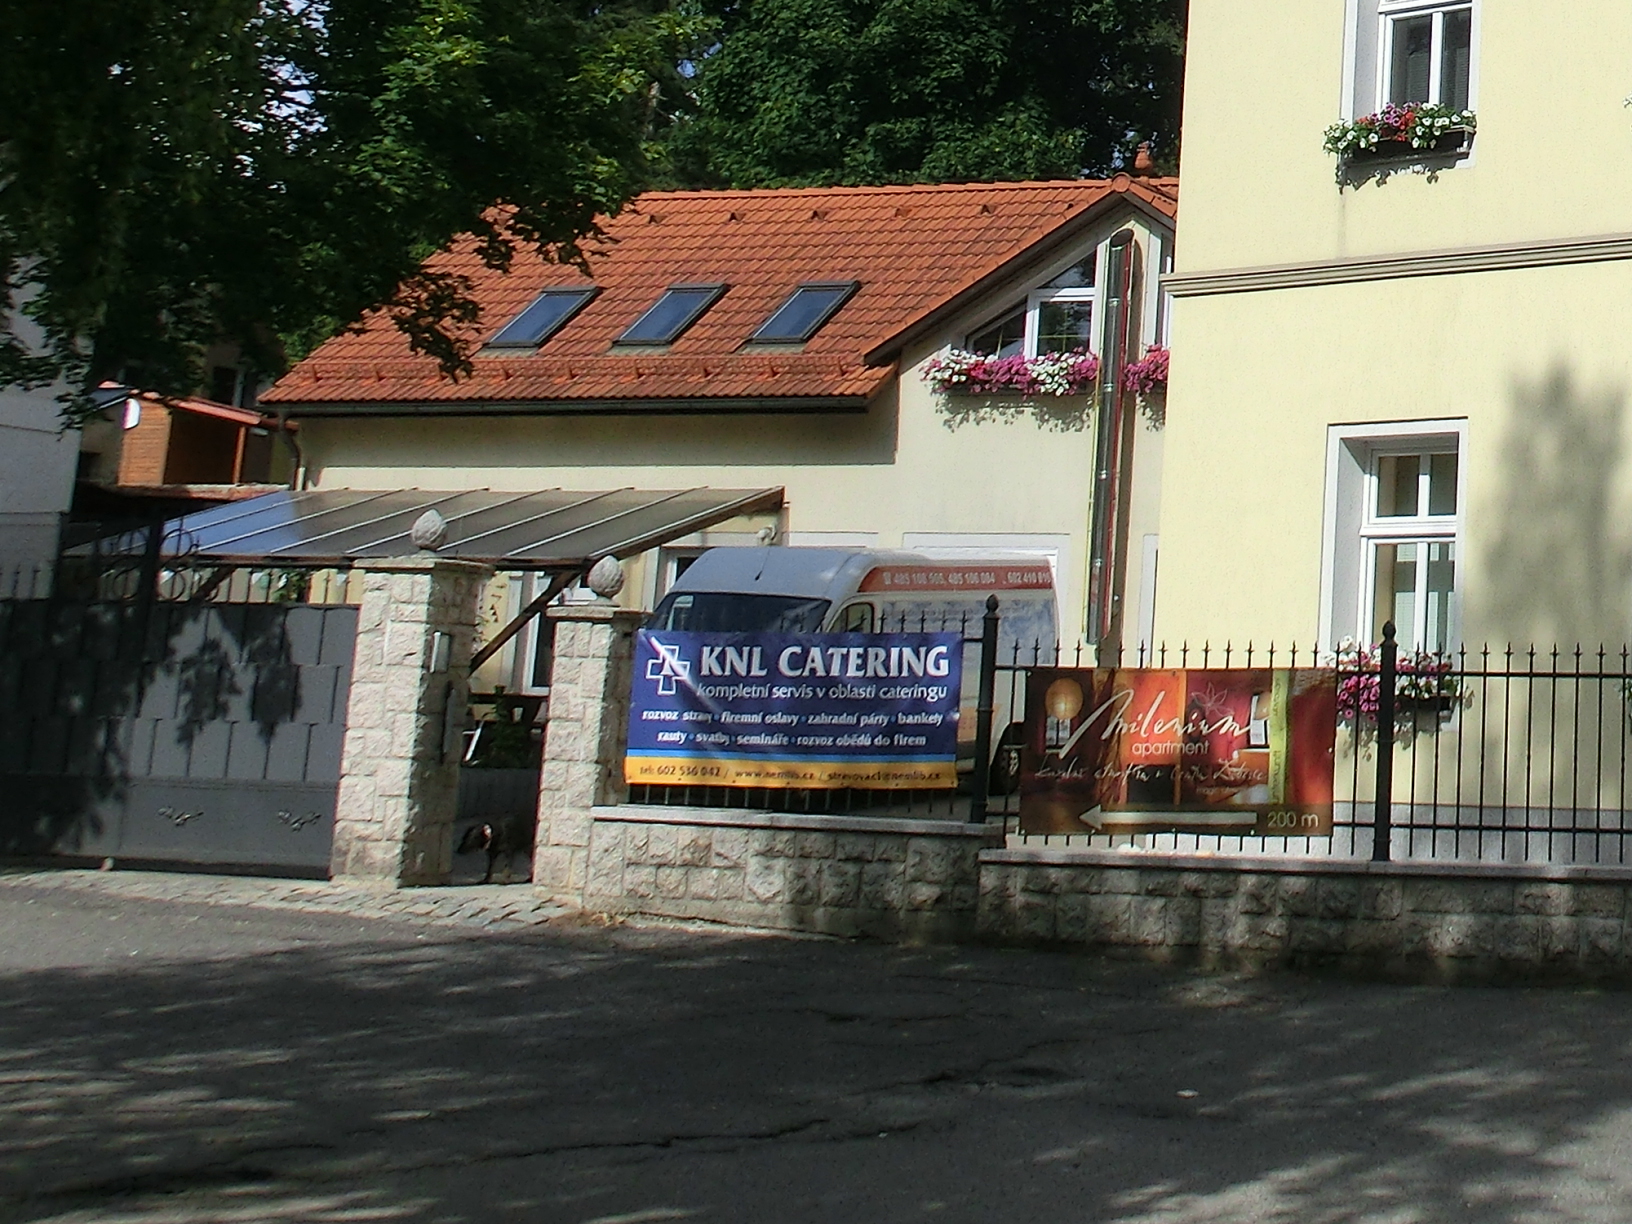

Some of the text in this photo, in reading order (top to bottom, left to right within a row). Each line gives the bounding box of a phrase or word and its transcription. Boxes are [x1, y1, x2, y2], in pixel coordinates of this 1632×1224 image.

[701, 645, 950, 677] KNL CATERING
[697, 683, 948, 702] kompletní servis v oblasti cateringu
[642, 710, 680, 721] rozvoz
[721, 711, 762, 724] firemní
[764, 712, 800, 725] oslavy
[807, 713, 857, 725] zahradní
[859, 713, 890, 727] párty
[897, 712, 944, 726] bankety
[737, 732, 790, 746] semináře
[796, 735, 834, 746] rozvoz
[835, 733, 872, 747] obědů
[874, 733, 891, 746] do
[893, 733, 927, 746] firem
[1131, 739, 1211, 757] apartment
[1267, 811, 1320, 828] 200 m
